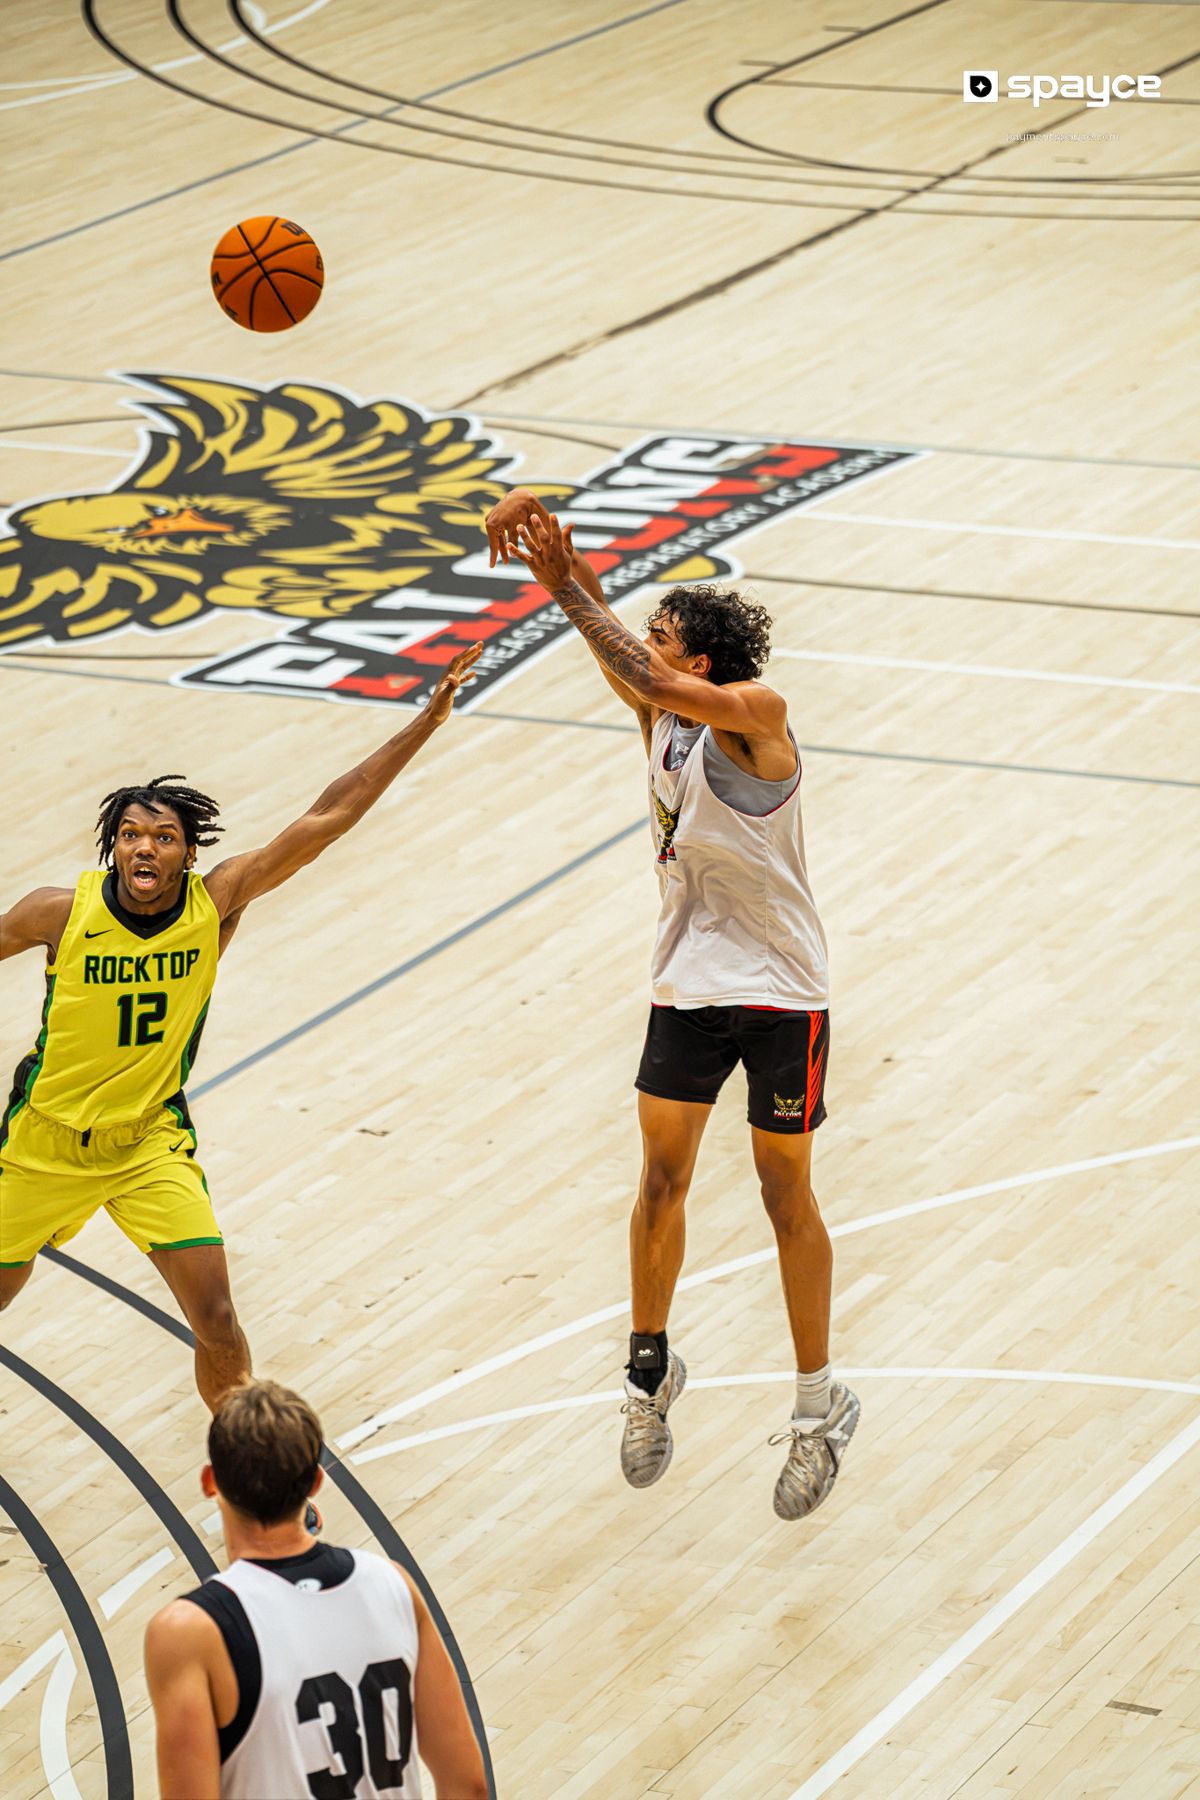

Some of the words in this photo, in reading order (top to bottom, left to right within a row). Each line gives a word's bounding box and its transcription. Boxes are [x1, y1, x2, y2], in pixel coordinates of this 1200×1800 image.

[761, 449, 898, 507] ACADEMY
[84, 948, 200, 984] ROCKTOP
[117, 991, 168, 1047] 12
[295, 1657, 414, 1800] 30
